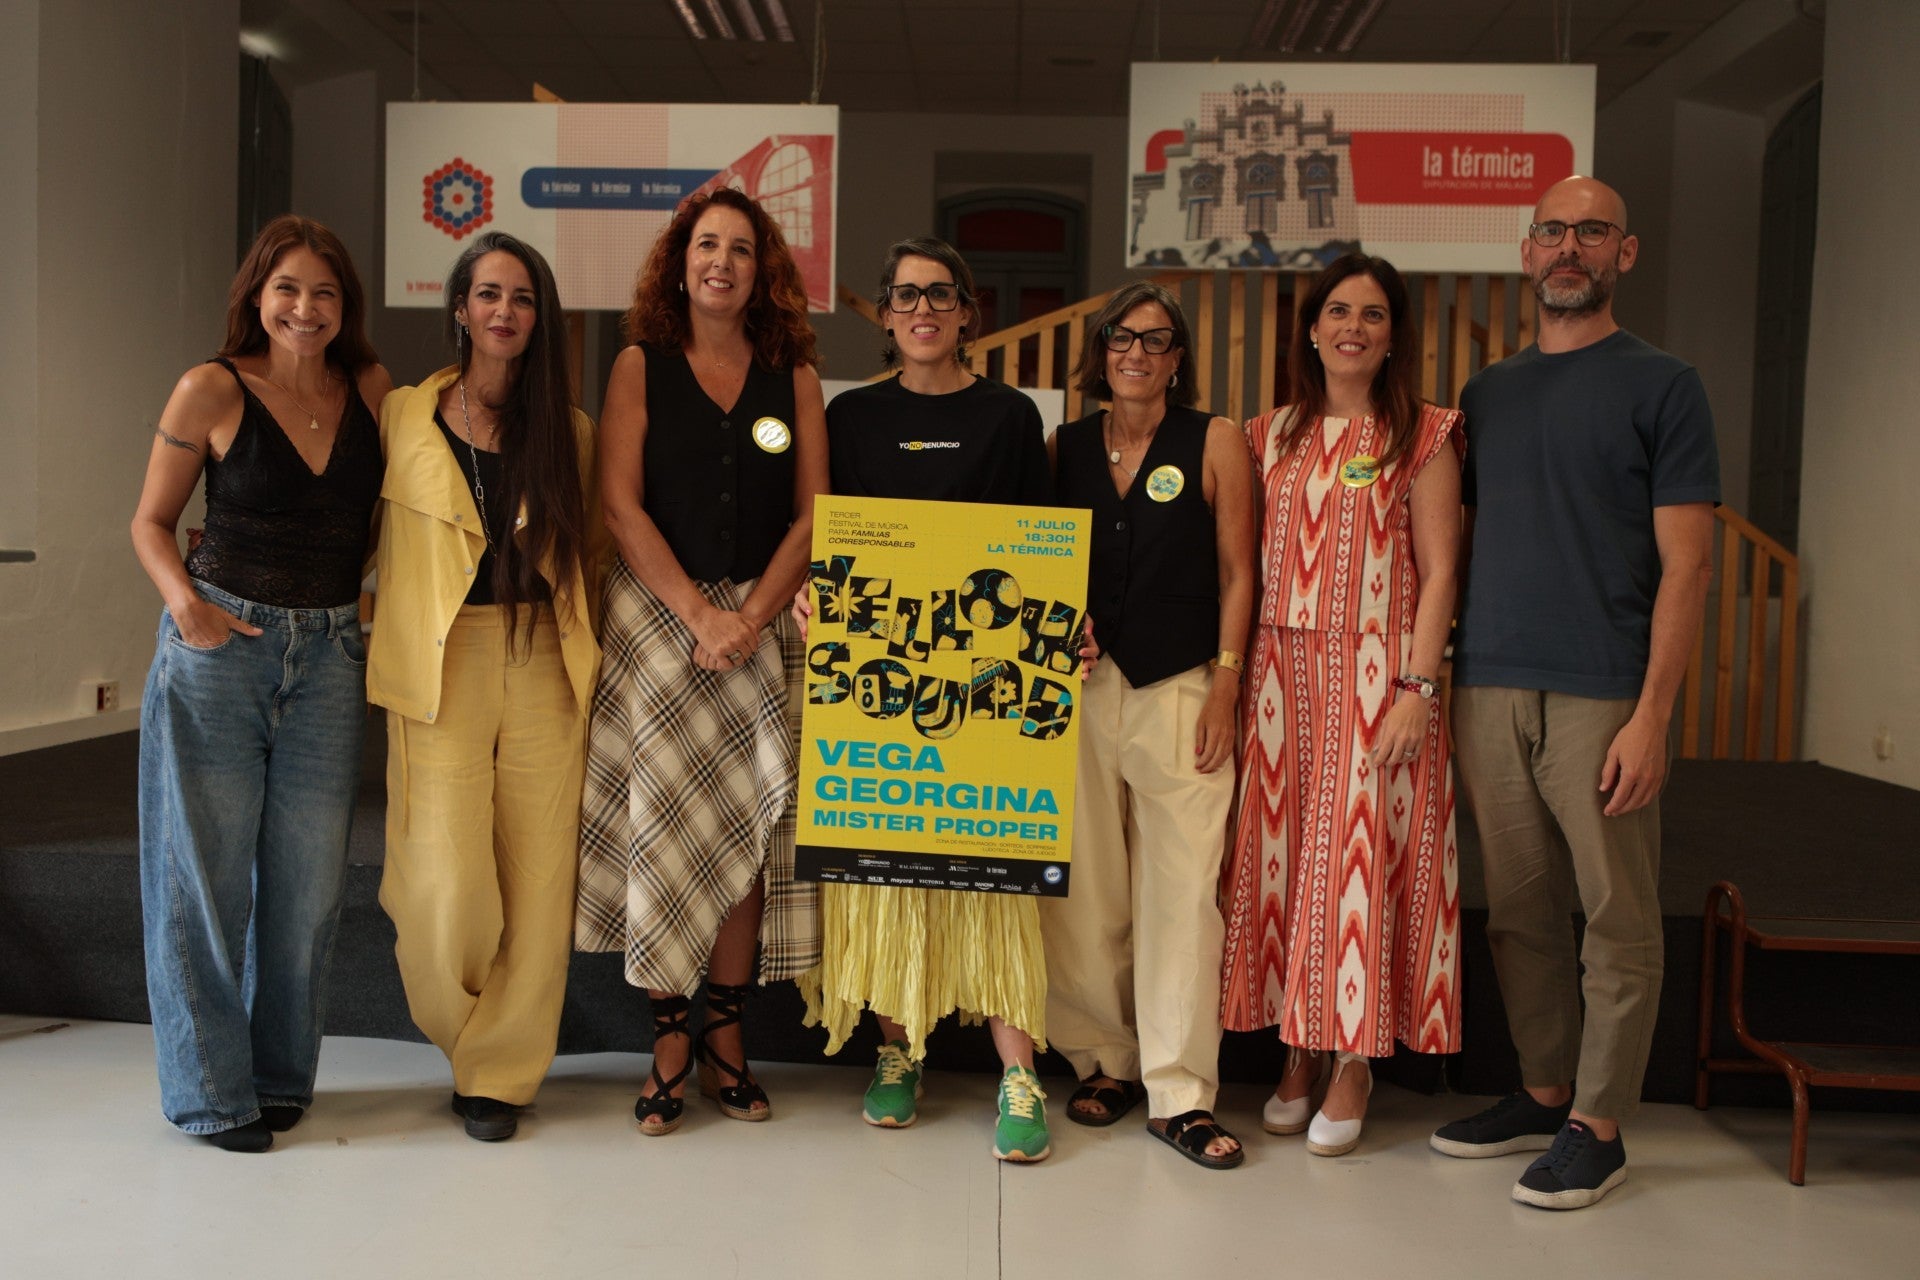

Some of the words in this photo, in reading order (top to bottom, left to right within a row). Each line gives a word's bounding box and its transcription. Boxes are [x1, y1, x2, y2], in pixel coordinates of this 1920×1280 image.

[1423, 146, 1442, 177] la
[1452, 146, 1534, 178] térmica
[542, 180, 550, 193] la
[592, 181, 600, 194] la
[642, 181, 650, 194] la
[830, 511, 861, 519] TERCER
[828, 519, 863, 528] FESTIVAL
[865, 521, 876, 529] DE
[878, 521, 909, 530] MÚSICA
[1017, 519, 1029, 528] 11
[1034, 520, 1076, 531] JULIO
[851, 530, 891, 538] FAMILIAS
[1025, 533, 1075, 544] 18:30H
[828, 537, 916, 548] CORRESPONSABLES
[987, 544, 1005, 553] LA
[1009, 544, 1074, 557] TÉRMICA
[810, 555, 1087, 676] YELLOW
[808, 642, 1074, 740] SOUND
[816, 739, 945, 773] VEGA
[814, 775, 1059, 815] GEORGINA
[813, 809, 925, 832] MISTER
[934, 817, 1059, 841] PROPER
